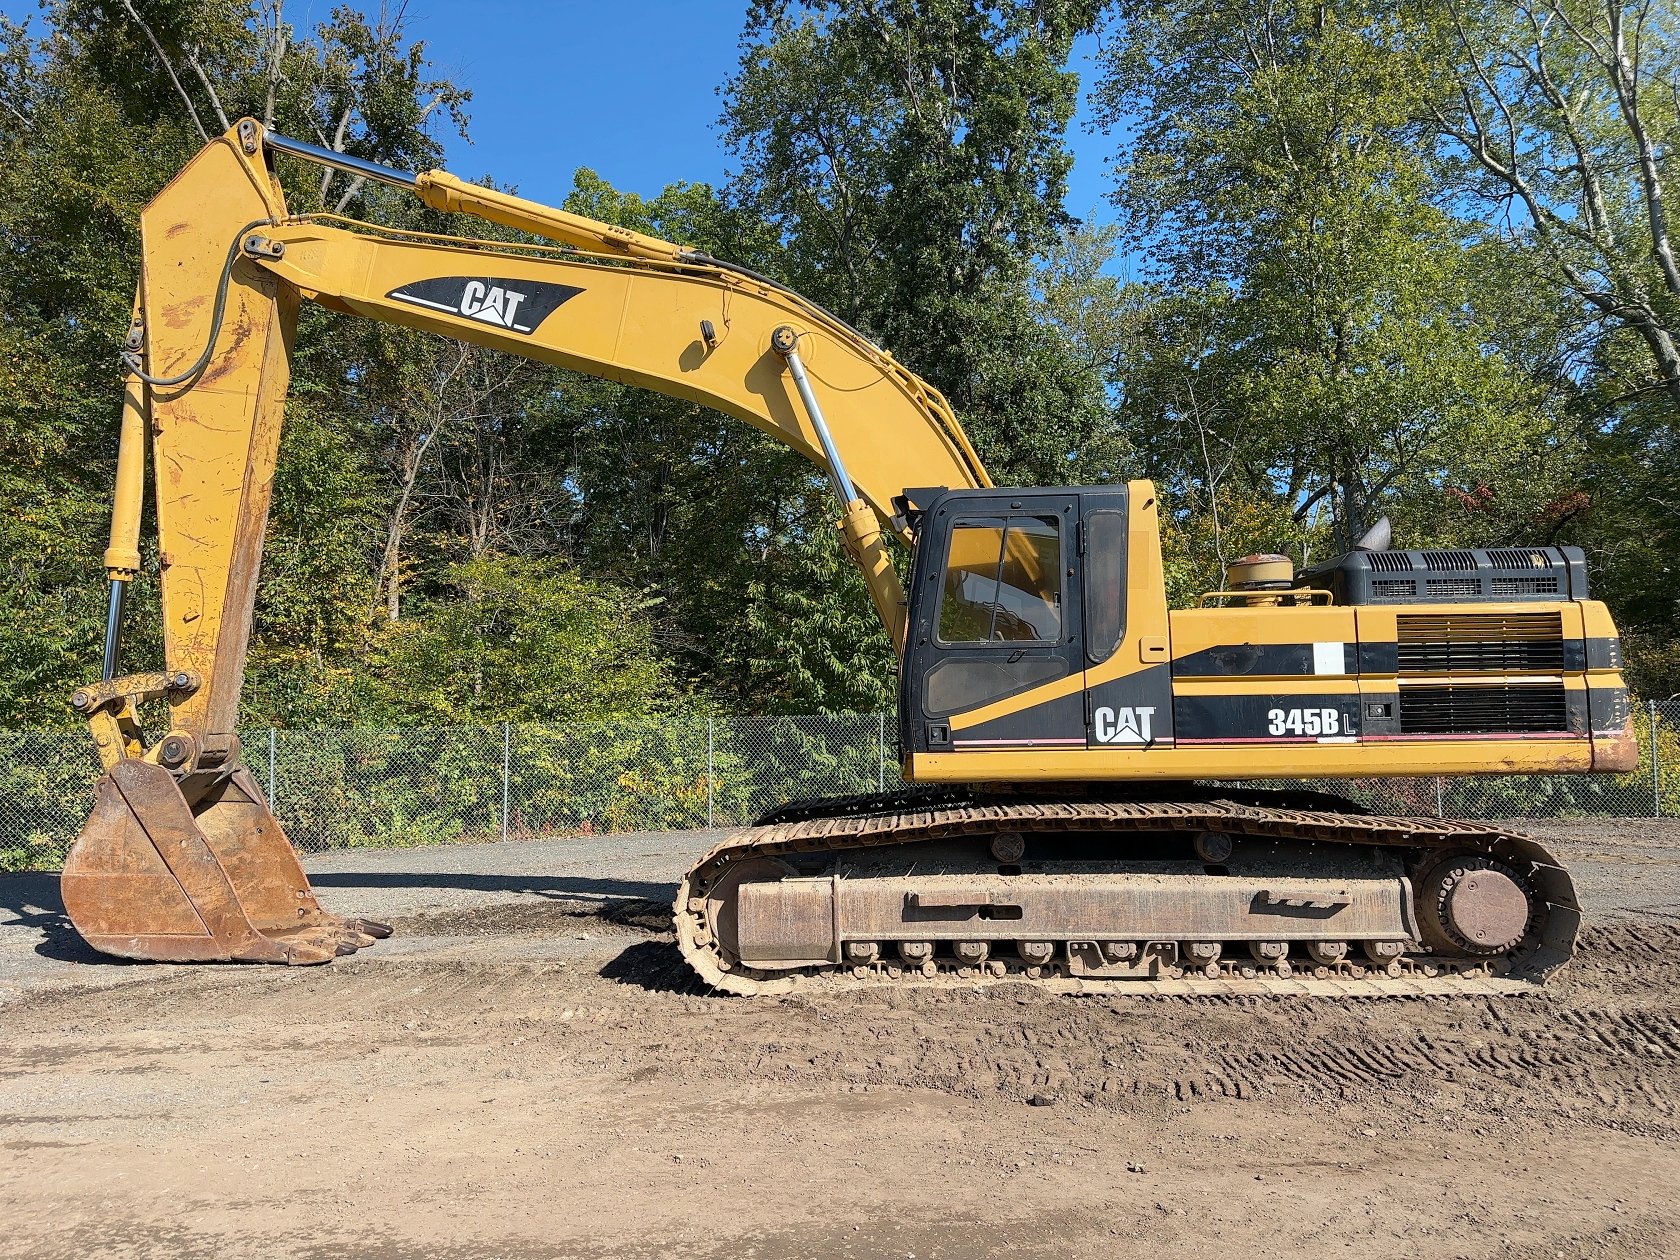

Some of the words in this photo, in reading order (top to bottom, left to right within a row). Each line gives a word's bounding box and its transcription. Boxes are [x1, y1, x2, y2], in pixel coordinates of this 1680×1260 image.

[460, 280, 525, 327] CAT
[1094, 706, 1155, 743] CAT
[1267, 708, 1339, 736] 345B
[1343, 713, 1356, 735] L
